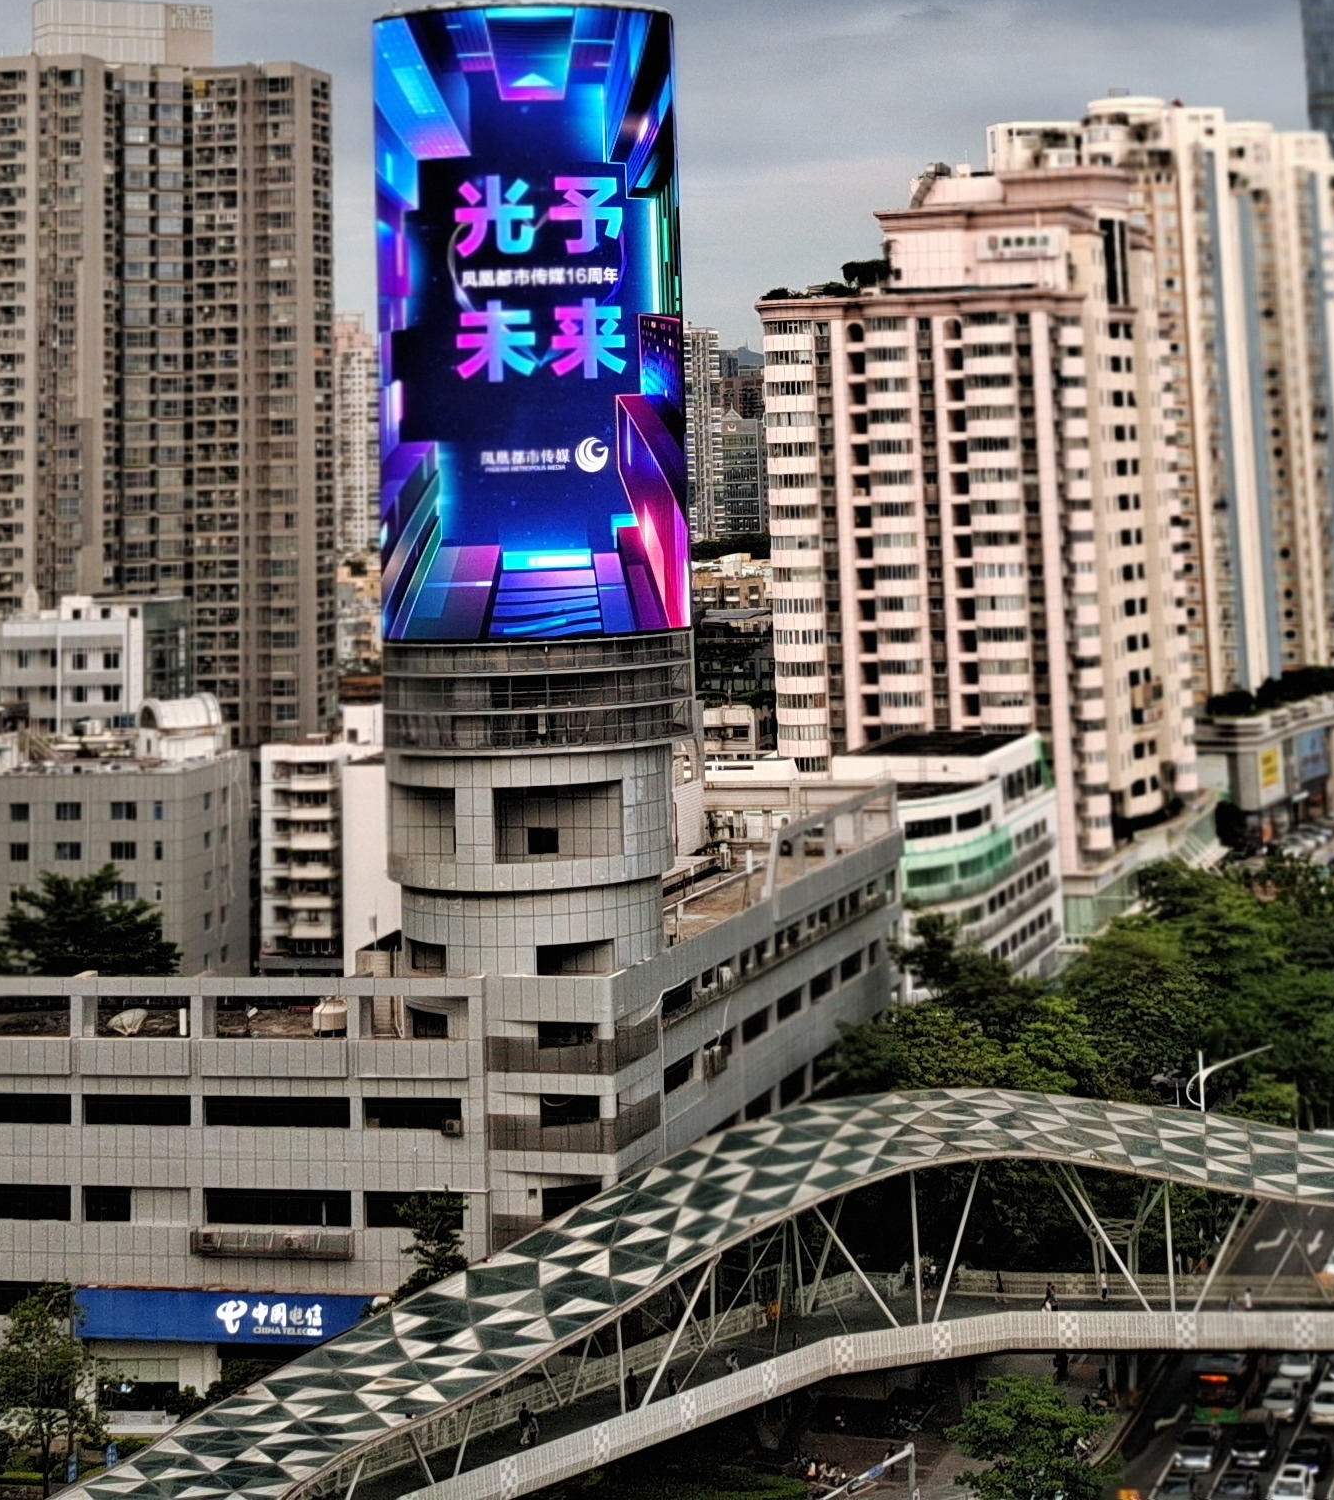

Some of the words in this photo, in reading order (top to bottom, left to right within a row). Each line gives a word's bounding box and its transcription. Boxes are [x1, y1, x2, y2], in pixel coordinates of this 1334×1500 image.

[455, 175, 622, 258] 光予
[462, 267, 619, 288] 凤凰都市传媒16周年
[456, 298, 626, 382] 未来
[252, 1301, 322, 1327] 中国电信
[253, 1326, 281, 1335] CHINA
[282, 1327, 322, 1336] TELECOM
